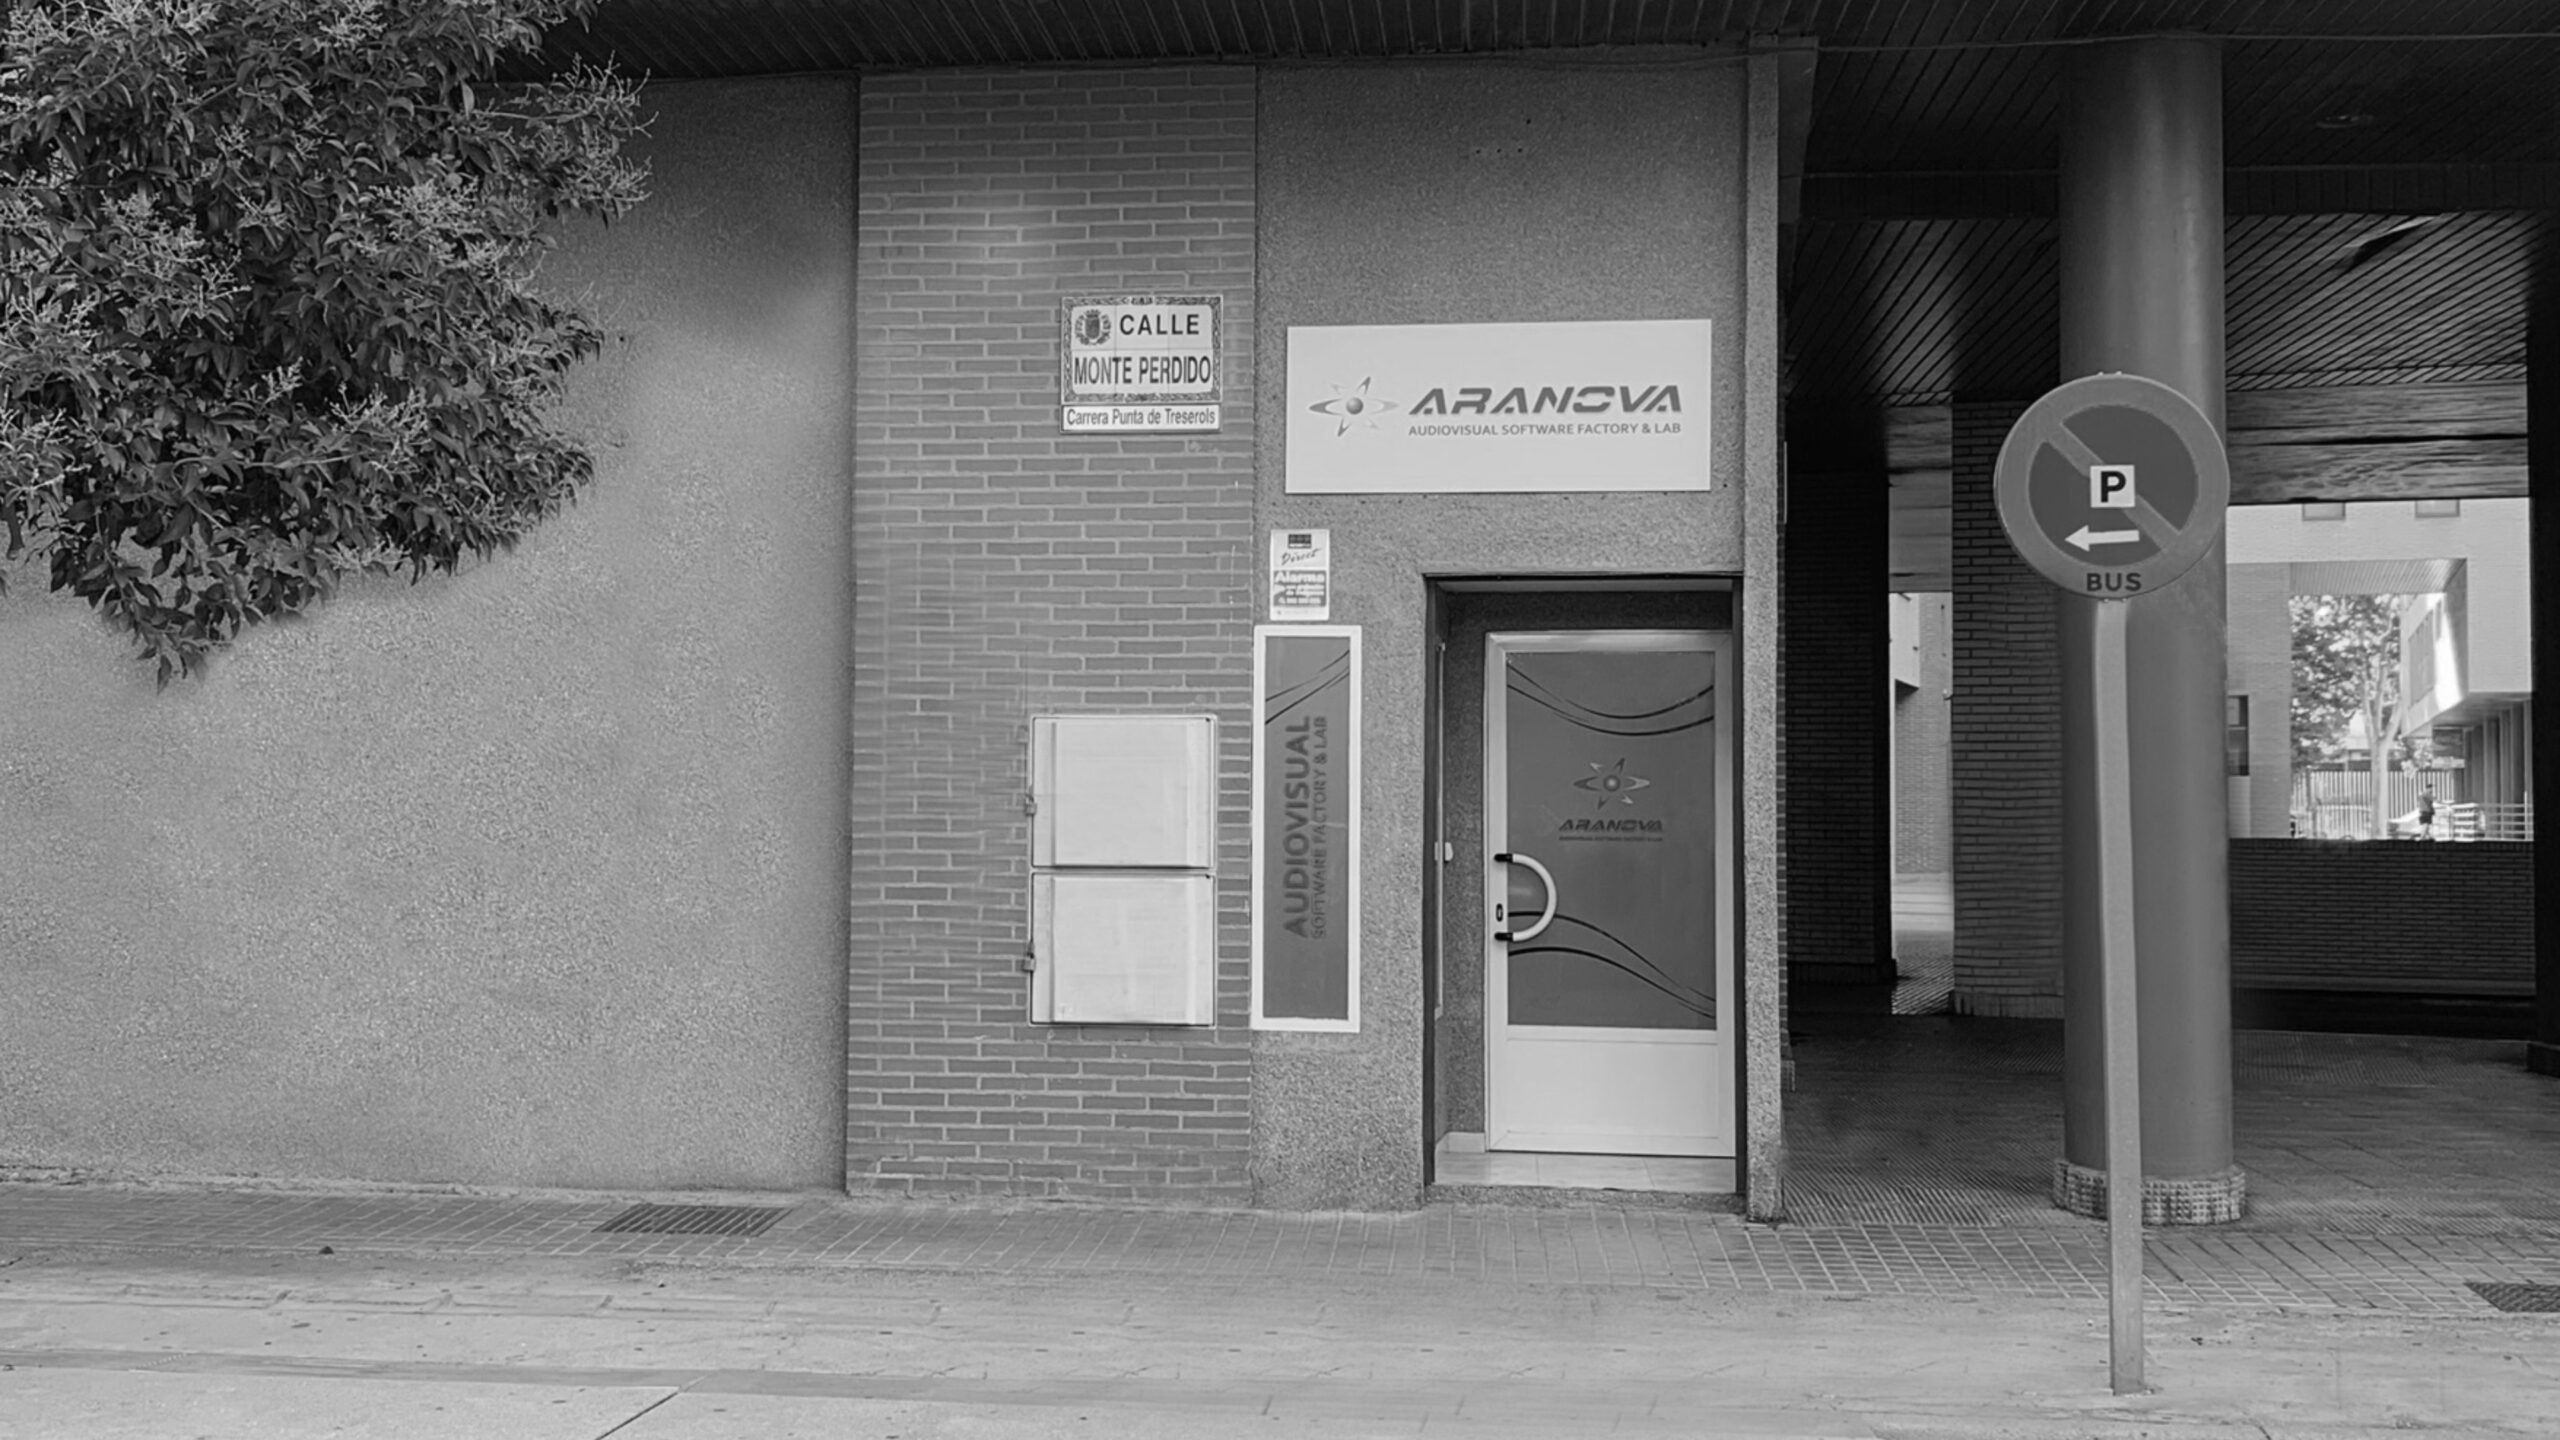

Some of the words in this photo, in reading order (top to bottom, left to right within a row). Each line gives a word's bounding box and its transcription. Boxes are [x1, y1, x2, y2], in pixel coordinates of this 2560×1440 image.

[1119, 313, 1200, 336] CALLE
[1074, 356, 1132, 384] MONTE
[1138, 355, 1211, 384] PERDIDO
[1408, 385, 1682, 415] ARANOVA
[1066, 408, 1109, 425] Carrera
[1112, 408, 1144, 425] Punta
[1147, 408, 1161, 425] de
[1165, 407, 1216, 425] Treserols
[1408, 424, 1498, 437] AUDIOVISUAL
[1501, 423, 1575, 436] SOFTWARE
[1577, 422, 1639, 435] FACTORY
[1641, 422, 1651, 434] &
[1654, 422, 1682, 434] LAB
[2100, 470, 2127, 503] P
[2086, 572, 2142, 592] BUS
[1313, 716, 1328, 749] LAB
[1313, 753, 1328, 765] &
[1311, 769, 1328, 844] FACTORY
[1282, 716, 1310, 939] AUDIOVISUAL
[1558, 818, 1663, 832] ARANOVA
[1310, 849, 1328, 940] SOFTWARE
